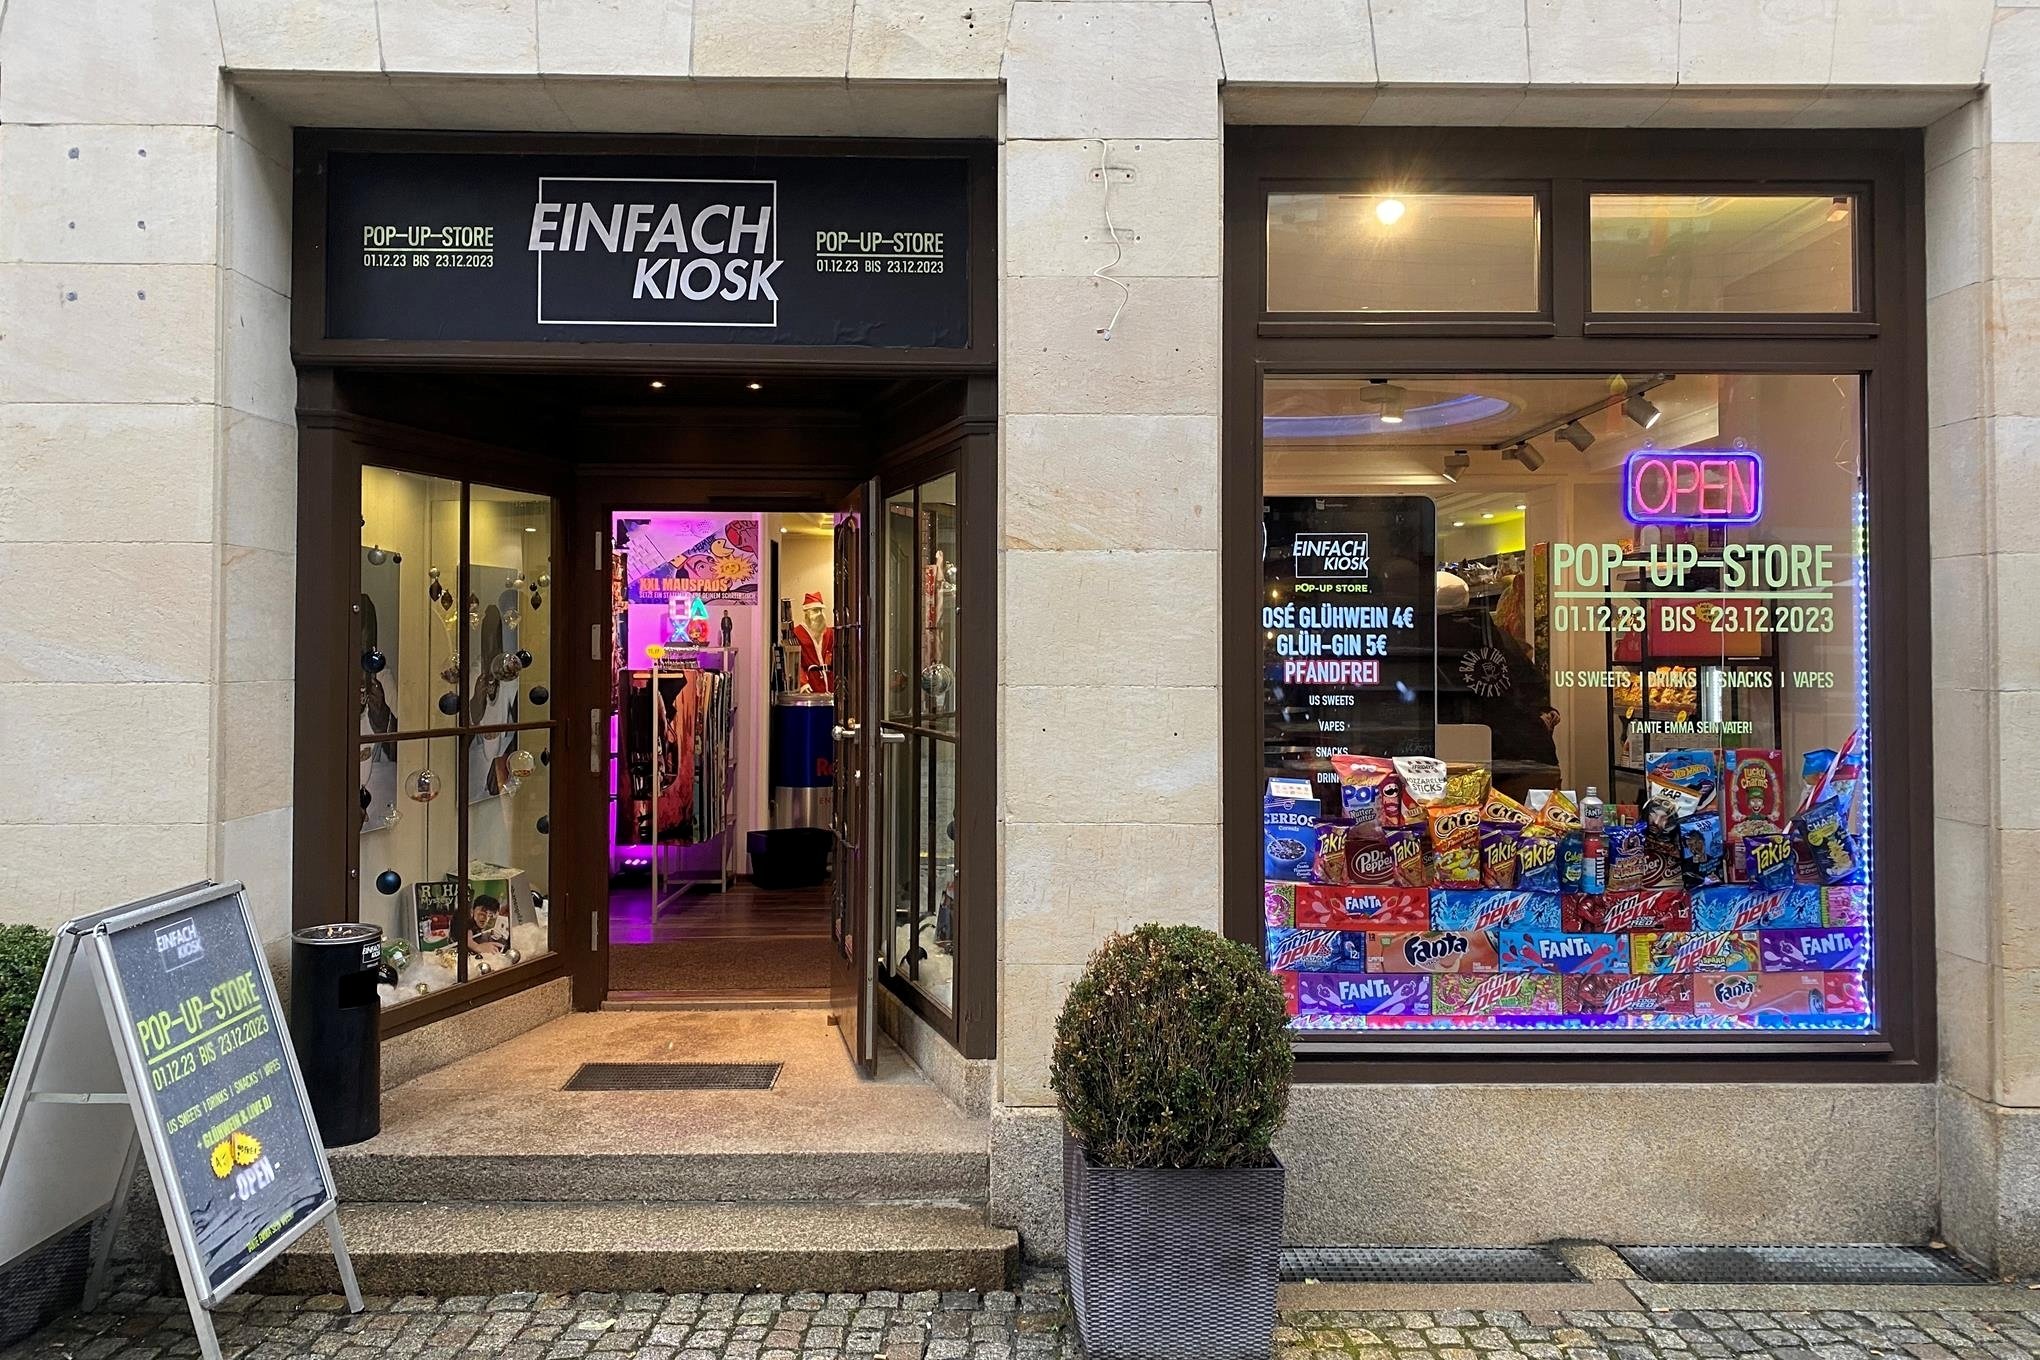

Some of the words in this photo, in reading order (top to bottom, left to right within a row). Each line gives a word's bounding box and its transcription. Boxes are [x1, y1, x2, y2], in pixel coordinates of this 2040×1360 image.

[363, 226, 493, 247] POP-UP-STORE
[528, 202, 772, 255] EINFACH
[816, 231, 943, 252] POP-UP-STORE
[363, 254, 406, 267] 01.12.23
[412, 255, 429, 267] BIS
[435, 254, 493, 267] 23.12.2023
[816, 259, 858, 272] 01.12.23
[865, 260, 881, 272] BIS
[887, 260, 943, 273] 23.12.2023
[633, 258, 783, 301] KIOSK
[1635, 459, 1755, 514] OPEN
[1292, 540, 1366, 556] EINFACH
[1323, 557, 1370, 570] KIOSK
[1553, 543, 1833, 588] POP-UP-STORE
[663, 578, 728, 591] MAUSPADS
[1295, 584, 1333, 592] POP-UP
[1299, 603, 1388, 629] GLÜHWEIN
[1392, 606, 1414, 629] 4€
[1554, 605, 1646, 632] 01.12.23
[1661, 606, 1696, 632] BIS
[1711, 606, 1834, 633] 23.12.2023
[1276, 631, 1362, 656] GLÜH-GIN
[1366, 634, 1387, 656] 5€
[1285, 660, 1379, 683] PFANDFREI
[1555, 671, 1574, 688] US
[1578, 671, 1631, 688] SWEETS
[1647, 671, 1697, 688] DRINKS
[1718, 671, 1772, 688] SNACKS
[1793, 671, 1834, 688] VAPES
[1309, 695, 1320, 706] US
[1322, 695, 1354, 706] SWEETS
[1319, 721, 1345, 731] VAPES
[1630, 722, 1662, 734] TANTE
[1665, 722, 1694, 734] EMMA
[1696, 722, 1719, 734] SEIN
[1722, 722, 1752, 734] VATER!
[1315, 747, 1348, 757] SNACKS
[1412, 784, 1443, 793] STICKS
[1517, 843, 1556, 873] Takis
[1751, 839, 1791, 874] Takis
[1344, 895, 1382, 911] FANTA
[156, 924, 198, 952] EINFACH
[1405, 932, 1468, 966] Fanta
[1539, 937, 1592, 960] FANTA
[1801, 933, 1853, 956] FANTA
[1338, 979, 1393, 1000] FANTA
[1715, 981, 1754, 1003] Fanta
[137, 970, 260, 1056] POP-UP-STORE
[152, 1051, 197, 1091] 01.12.23
[198, 1040, 217, 1067] BIS
[218, 1014, 269, 1055] 23.12.2023
[166, 1118, 179, 1135] US
[177, 1104, 202, 1129] SWEETS
[234, 1071, 259, 1094] SNACKS
[236, 1155, 276, 1201] OPEN
